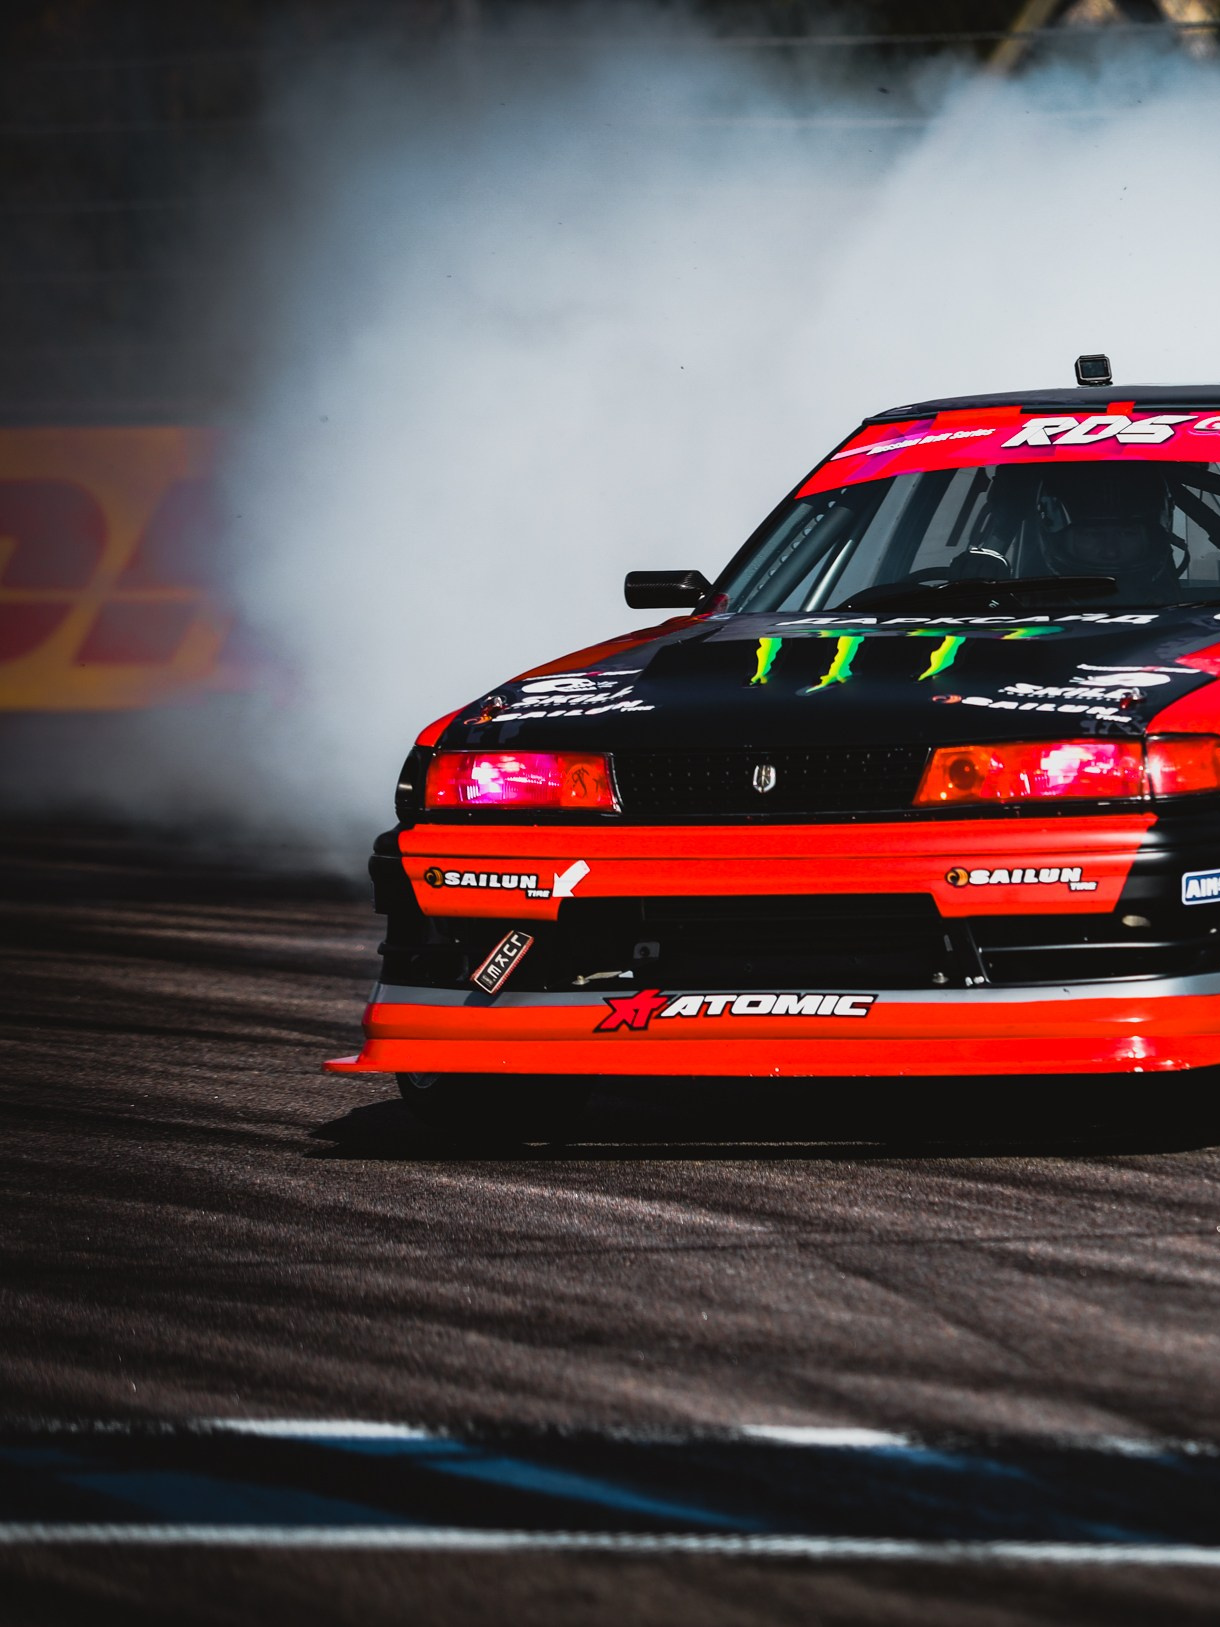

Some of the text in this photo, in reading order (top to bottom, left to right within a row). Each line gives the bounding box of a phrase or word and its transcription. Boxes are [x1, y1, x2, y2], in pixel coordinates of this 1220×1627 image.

[1001, 415, 1199, 448] RDS
[492, 700, 643, 722] SAILUN
[962, 696, 1119, 715] SAILUN
[444, 872, 537, 889] SAILUN
[969, 868, 1082, 884] SAILUN
[660, 994, 875, 1017] ATOMIC
